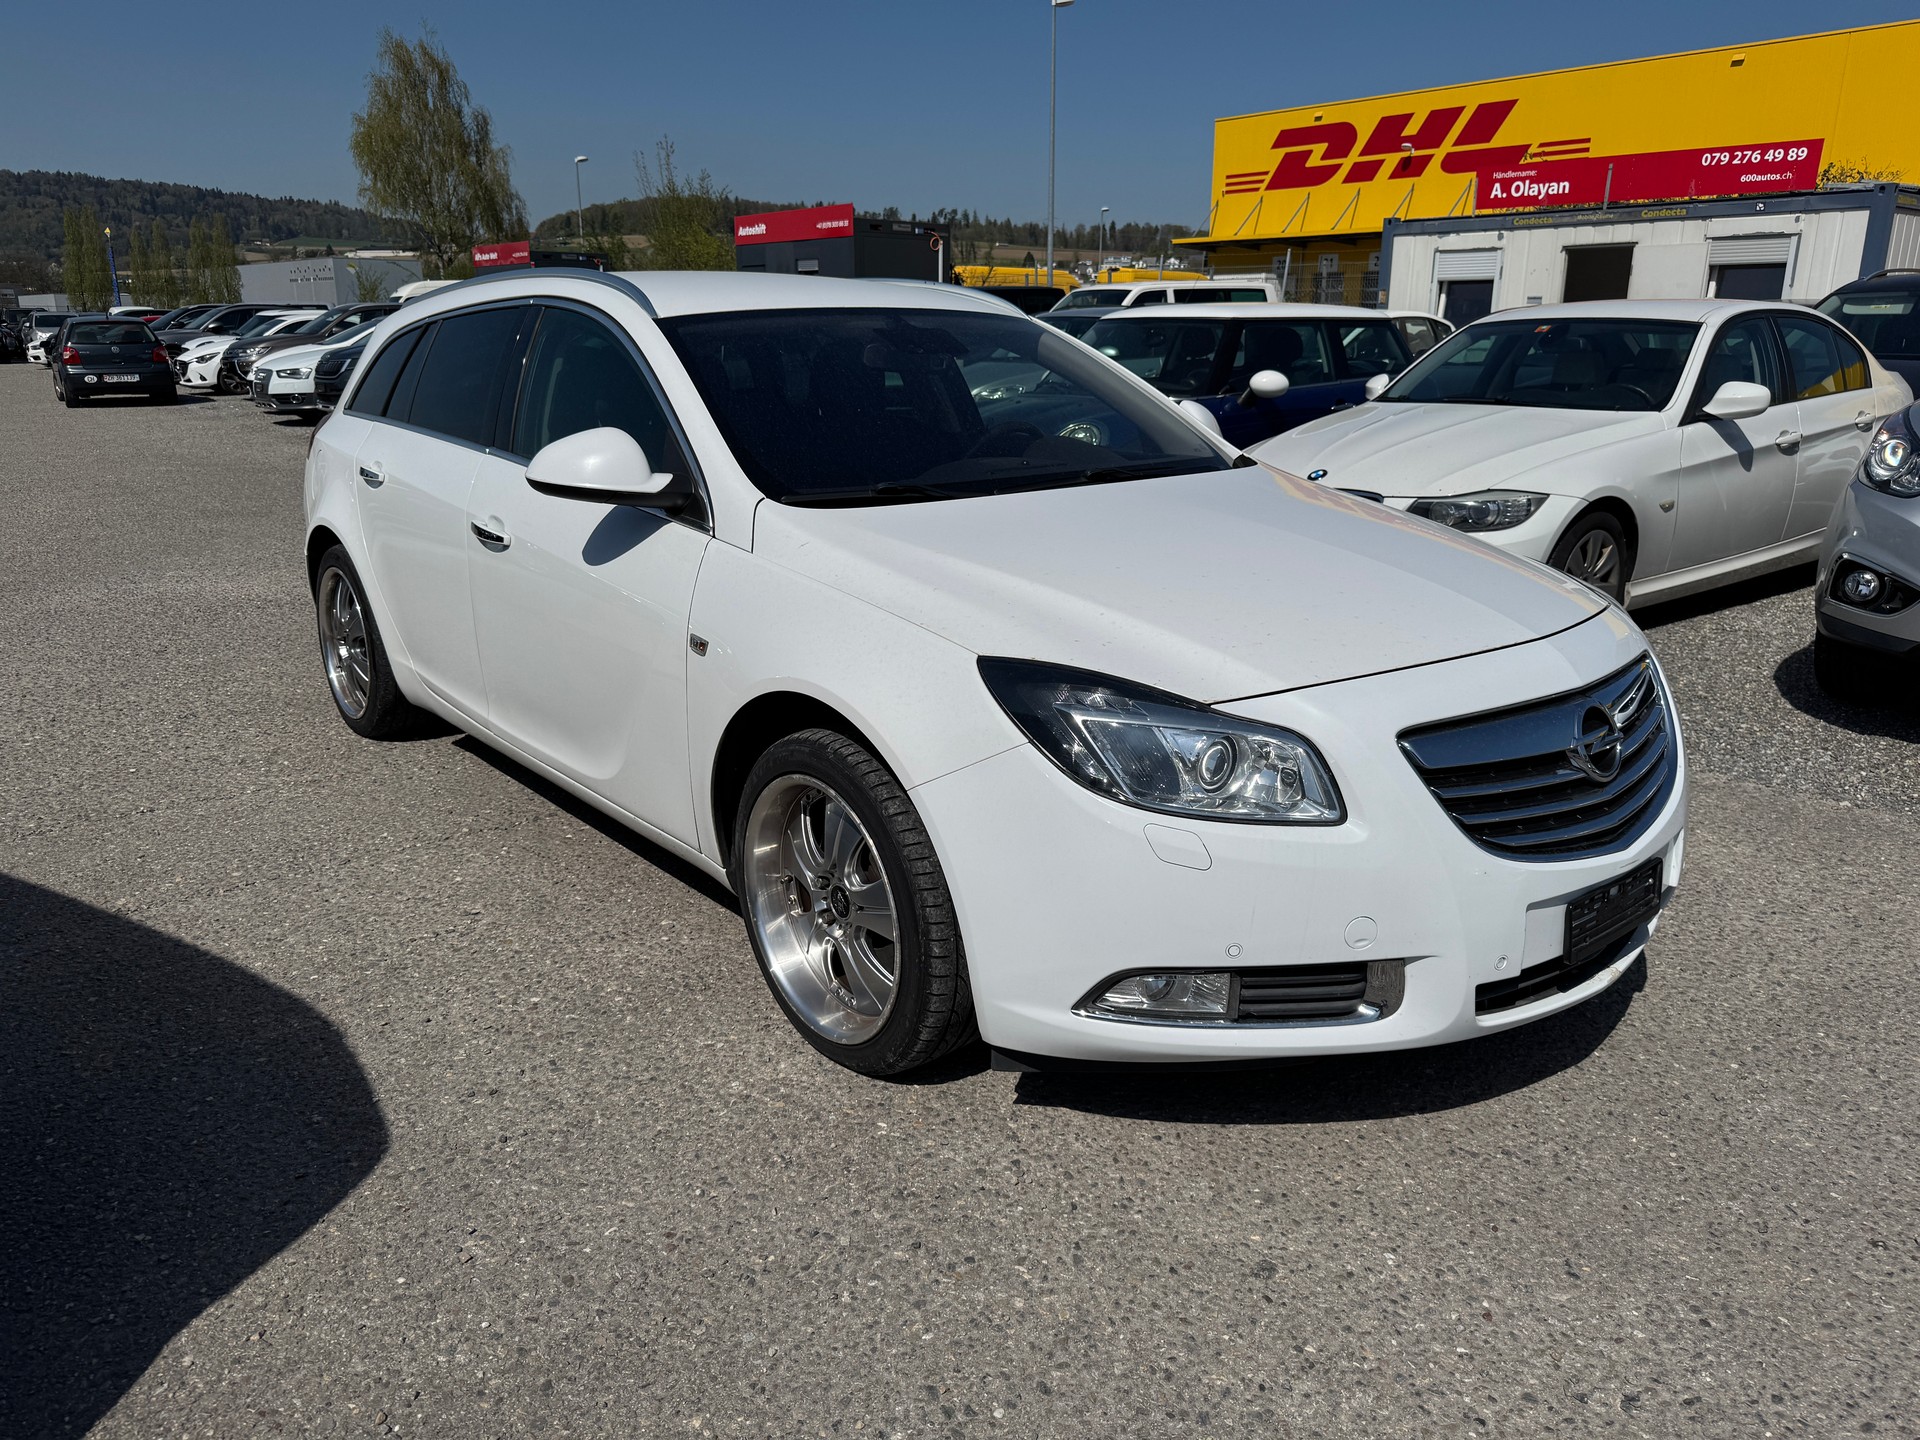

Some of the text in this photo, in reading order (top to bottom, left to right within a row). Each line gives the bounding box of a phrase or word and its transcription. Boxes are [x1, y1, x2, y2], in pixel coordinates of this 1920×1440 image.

[1263, 98, 1532, 191] DHL
[1701, 147, 1808, 166] 079 276 49 89
[1493, 170, 1537, 180] Händlername:
[1740, 171, 1792, 182] 600autos.ch
[1490, 180, 1569, 200] A. Olayan
[1640, 208, 1687, 218] Condecta
[1513, 217, 1553, 226] Condecta
[738, 223, 767, 236] Autoshift
[1374, 256, 1380, 267] 2
